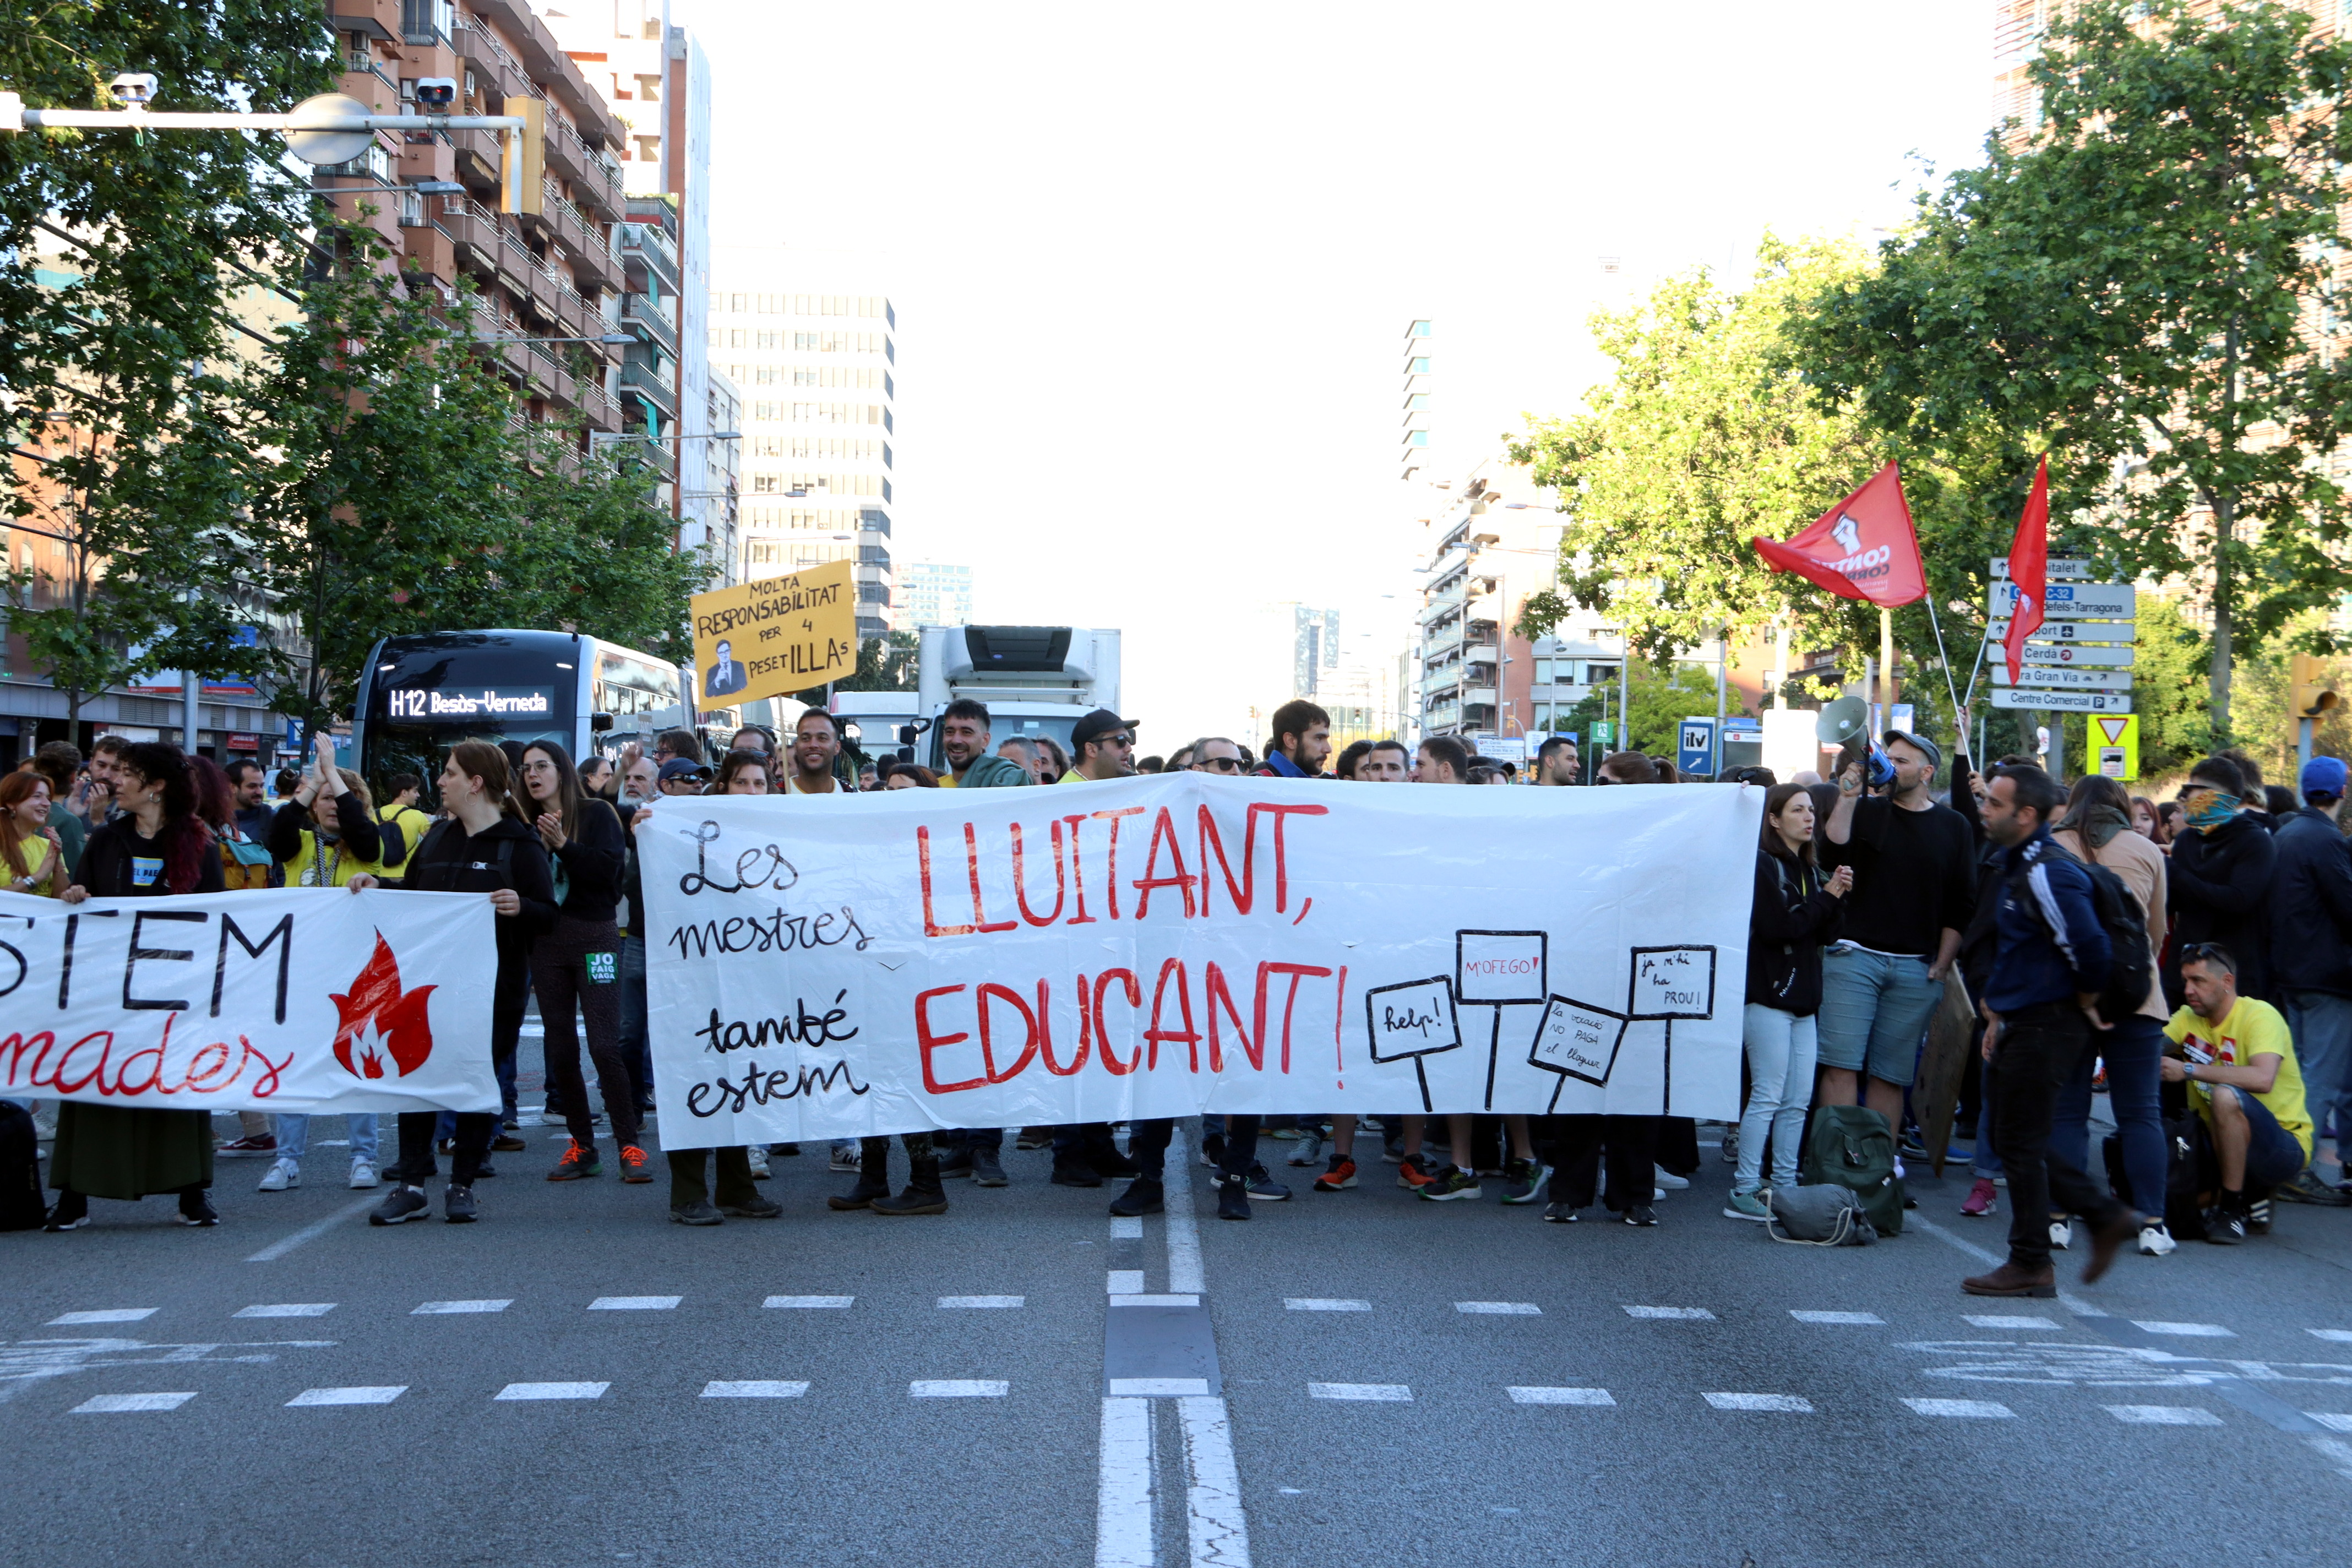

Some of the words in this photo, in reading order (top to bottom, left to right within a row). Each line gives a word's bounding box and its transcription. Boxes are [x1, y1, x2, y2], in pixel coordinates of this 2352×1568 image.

[749, 576, 800, 599] MOLTA
[2046, 587, 2069, 600] C-32
[759, 626, 782, 643] PER
[802, 618, 813, 632] 4
[2034, 625, 2057, 637] port
[2024, 647, 2057, 659] Cerdà
[2034, 671, 2059, 682] Gran
[2062, 672, 2078, 682] Via
[391, 689, 426, 716] H12
[431, 690, 547, 714] Besòs-Verneda
[2011, 692, 2041, 704] Centre
[2044, 694, 2089, 706] Comercial
[679, 819, 798, 896] Les
[917, 802, 1330, 937] LLUITANT,
[668, 905, 875, 960] mestres
[590, 953, 614, 966] JO
[591, 965, 614, 973] FAIG
[1464, 956, 1539, 977] M'OFEGO!
[1641, 954, 1656, 978] ja
[1652, 973, 1671, 986] ha
[694, 988, 859, 1054] també
[1383, 997, 1441, 1038] help!
[1550, 1004, 1563, 1017] la
[1571, 1014, 1605, 1030] vocació
[1549, 1023, 1565, 1035] NO
[1574, 1030, 1599, 1046] PAGA
[1543, 1043, 1560, 1054] el
[1566, 1047, 1601, 1069] lloguer
[686, 1059, 870, 1118] estem
